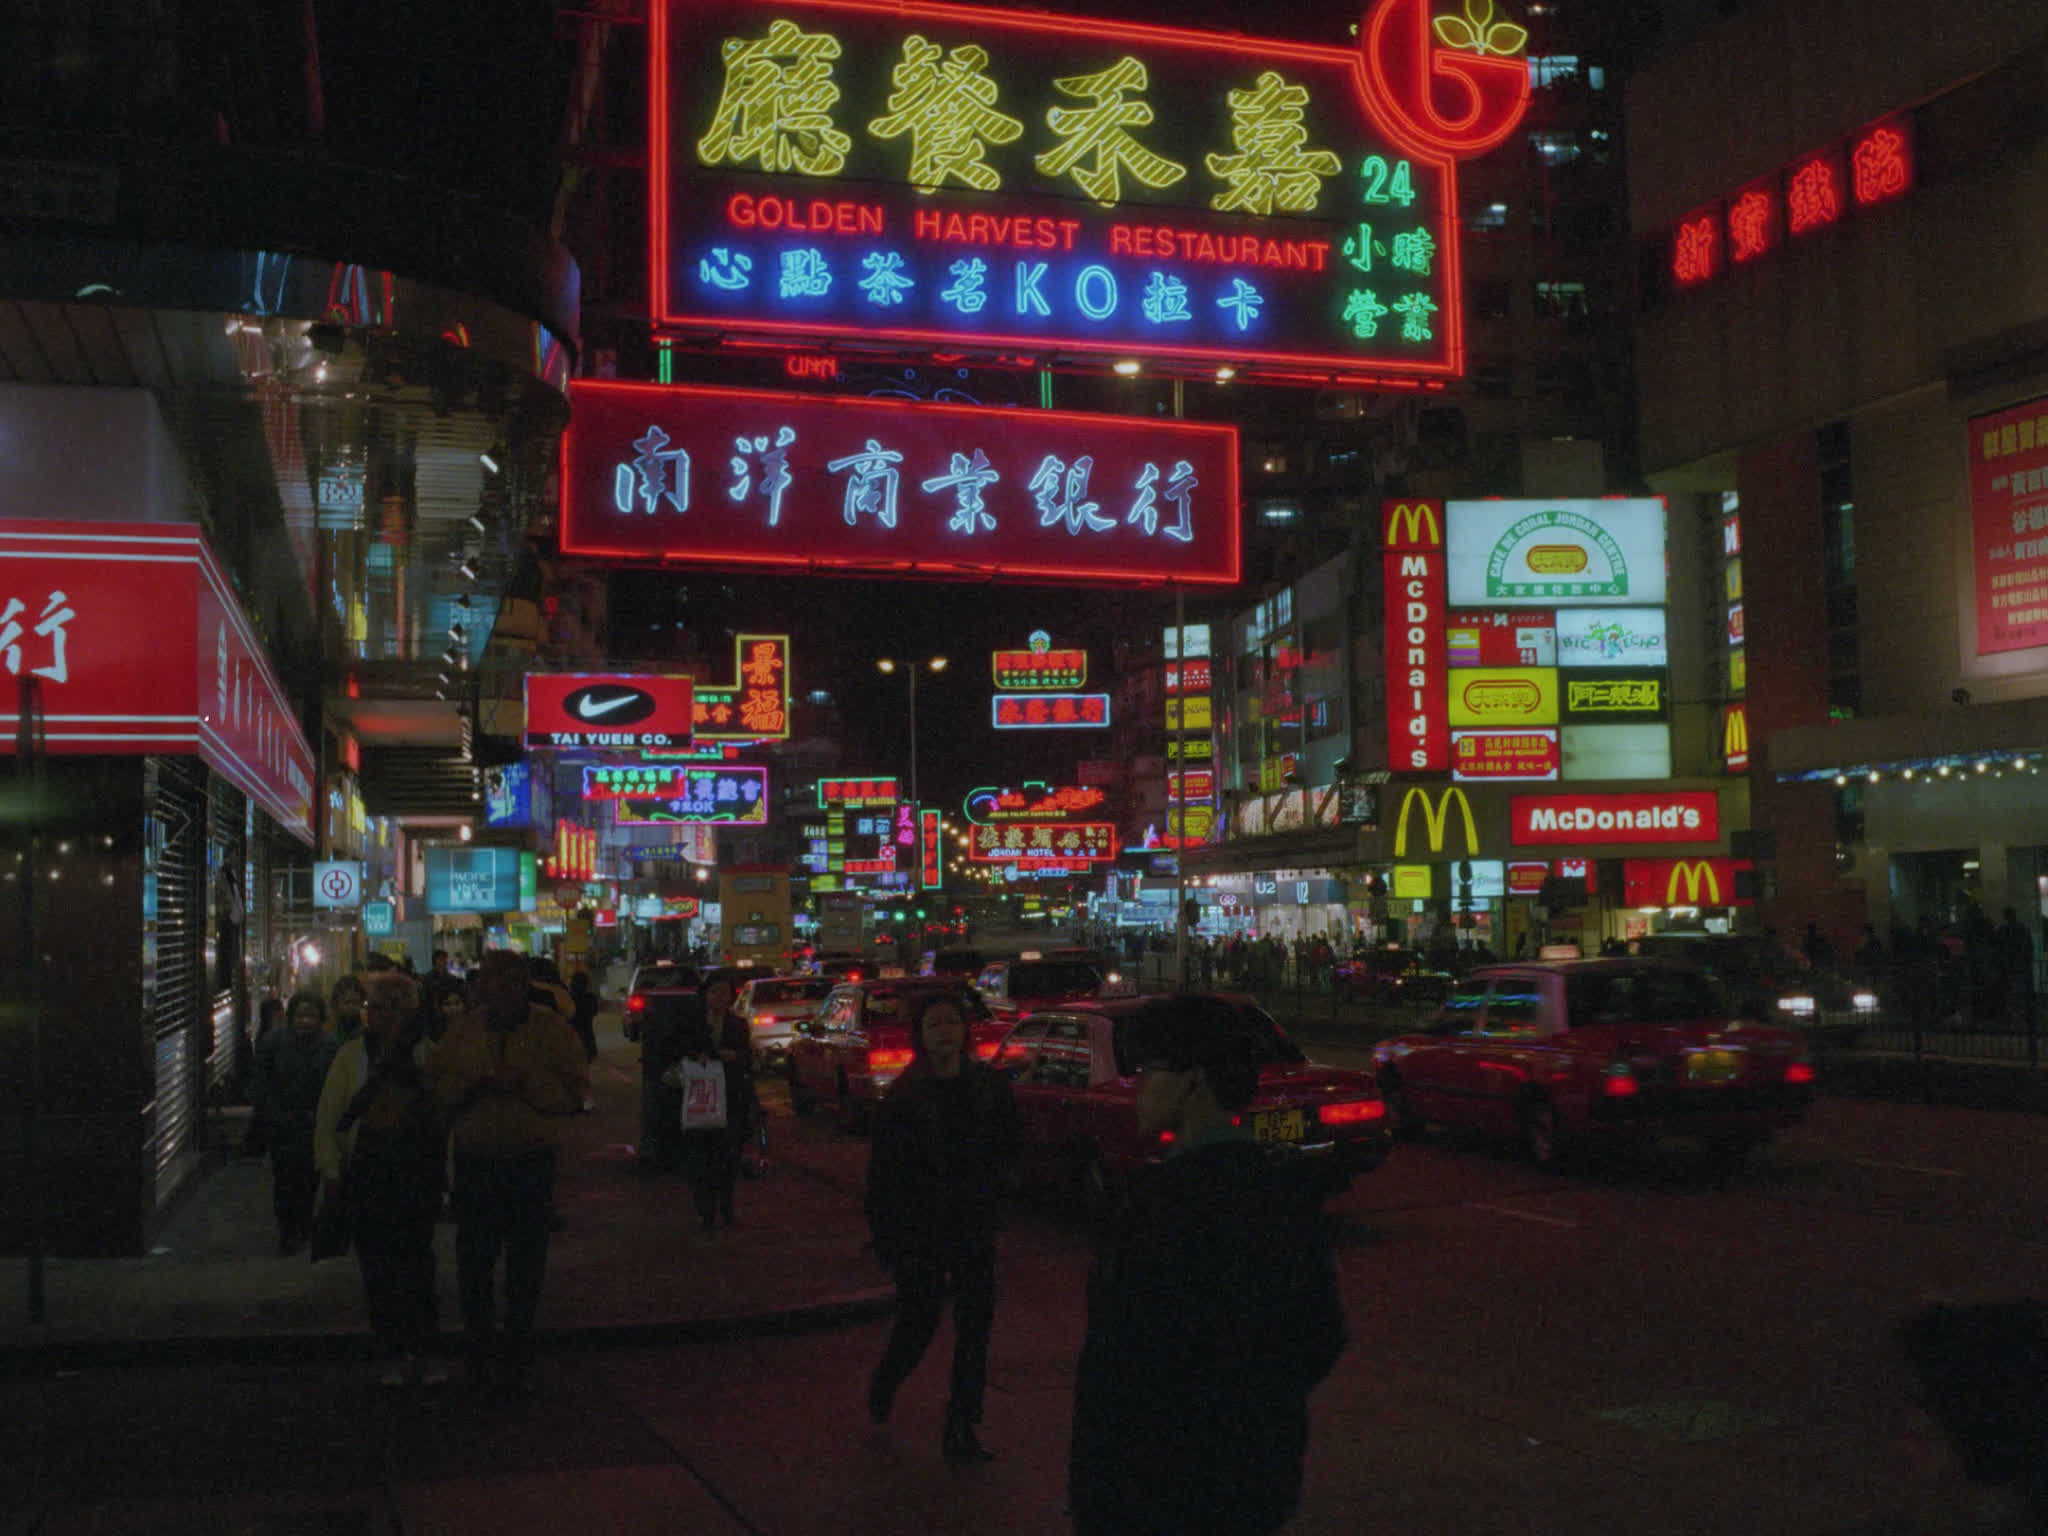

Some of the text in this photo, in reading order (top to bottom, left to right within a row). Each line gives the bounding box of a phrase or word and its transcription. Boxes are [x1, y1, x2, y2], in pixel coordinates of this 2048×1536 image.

[1362, 156, 1417, 208] 24
[728, 194, 1330, 272] GOLDEN HARVEST RESTAURANT
[1343, 224, 1434, 277] 小時
[1343, 289, 1434, 343] 營業
[615, 425, 1201, 542] 南洋商業銀行
[551, 733, 672, 746] TAI YUEN CO.
[1530, 805, 1701, 831] McDonald's
[988, 848, 1022, 857] JORDAN
[1027, 848, 1056, 858] HOTEL
[1255, 881, 1277, 894] U2
